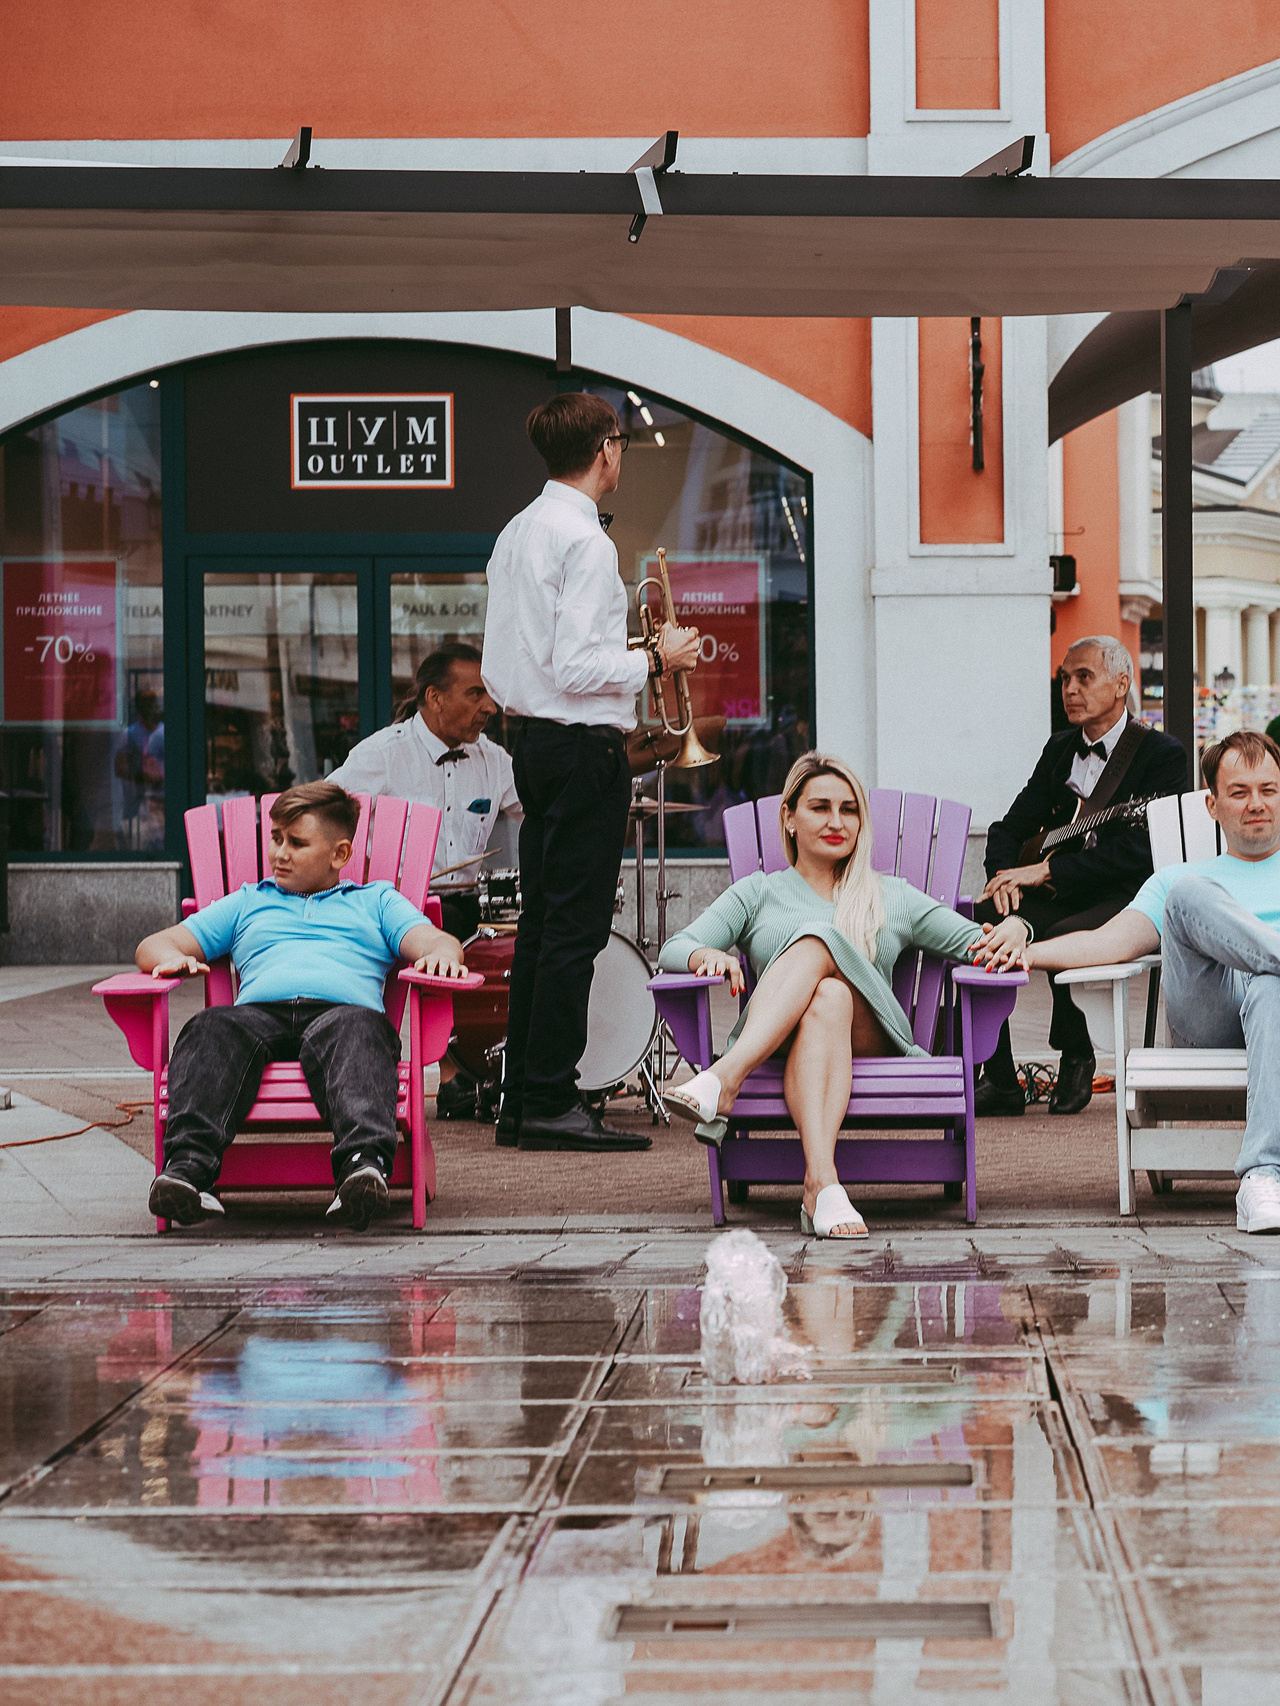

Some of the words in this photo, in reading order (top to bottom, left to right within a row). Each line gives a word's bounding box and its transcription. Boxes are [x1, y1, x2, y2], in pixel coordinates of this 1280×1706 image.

[308, 416, 437, 447] ЦУМ
[307, 454, 437, 474] OUTLET
[38, 593, 80, 603] ЛЕТНЕЕ
[681, 592, 724, 602] ЛЕТНЕЕ
[16, 605, 103, 616] ПРЕДЛОЖЕНИЕ
[124, 604, 162, 618] TELLA
[402, 603, 436, 616] PAUL
[440, 603, 448, 616] &
[453, 603, 479, 616] JOE
[661, 604, 746, 616] ЕДЛОЖЕНИЕ
[24, 635, 95, 663] -70%
[699, 634, 739, 662] 0%
